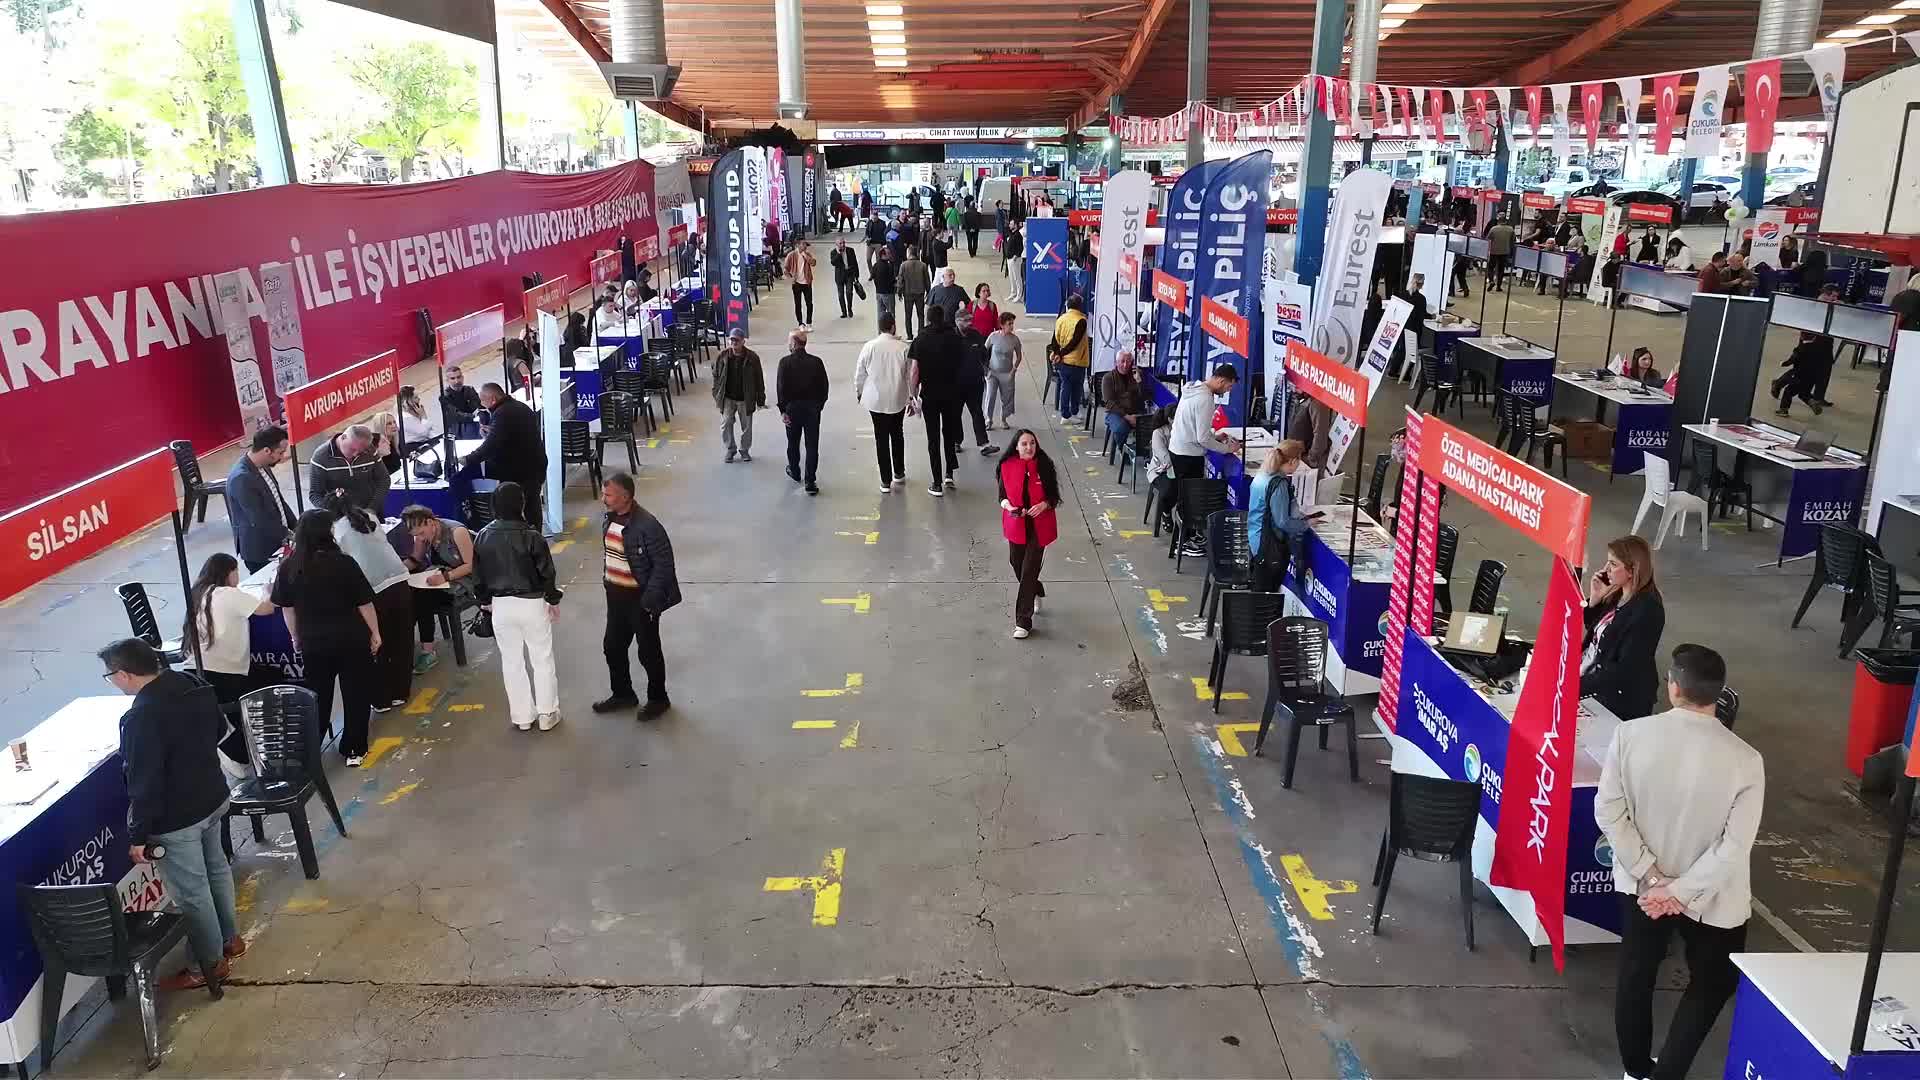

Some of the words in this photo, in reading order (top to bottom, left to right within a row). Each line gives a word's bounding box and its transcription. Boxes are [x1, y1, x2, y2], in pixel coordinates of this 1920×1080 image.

[725, 164, 741, 212] LTD.
[1207, 183, 1258, 280] PİLİÇ
[290, 237, 353, 310] İLE
[348, 222, 497, 304] İŞVERENLER
[498, 206, 594, 266] ÇUKUROVA'DA
[727, 218, 742, 297] GROUP
[1334, 209, 1375, 308] Eurest
[1276, 303, 1302, 320] beyza
[1274, 333, 1287, 345] HOŞ
[1290, 349, 1309, 379] İHLAS
[1309, 366, 1355, 407] PAZARLAMA
[1510, 386, 1545, 395] KOZAY
[1511, 379, 1546, 387] EMRAH
[303, 389, 345, 423] AVRUPA
[345, 362, 394, 402] HASTANESİ
[1628, 437, 1668, 446] KOZAY
[1629, 429, 1670, 438] EMRAH
[1440, 431, 1466, 464] ÖZEL
[1466, 450, 1546, 510] MEDİCALPARK
[1442, 460, 1476, 493] ADANA
[1477, 479, 1541, 531] HASTANESİ
[1804, 501, 1852, 510] EMRAH
[1803, 510, 1851, 521] KOZAY
[27, 500, 109, 561] SİLSAN
[250, 652, 304, 663] MRAH
[1418, 690, 1458, 743] ÇUKUROVA
[1436, 729, 1449, 753] AŞ
[1481, 778, 1501, 804] BELE
[1569, 884, 1616, 894] BELED
